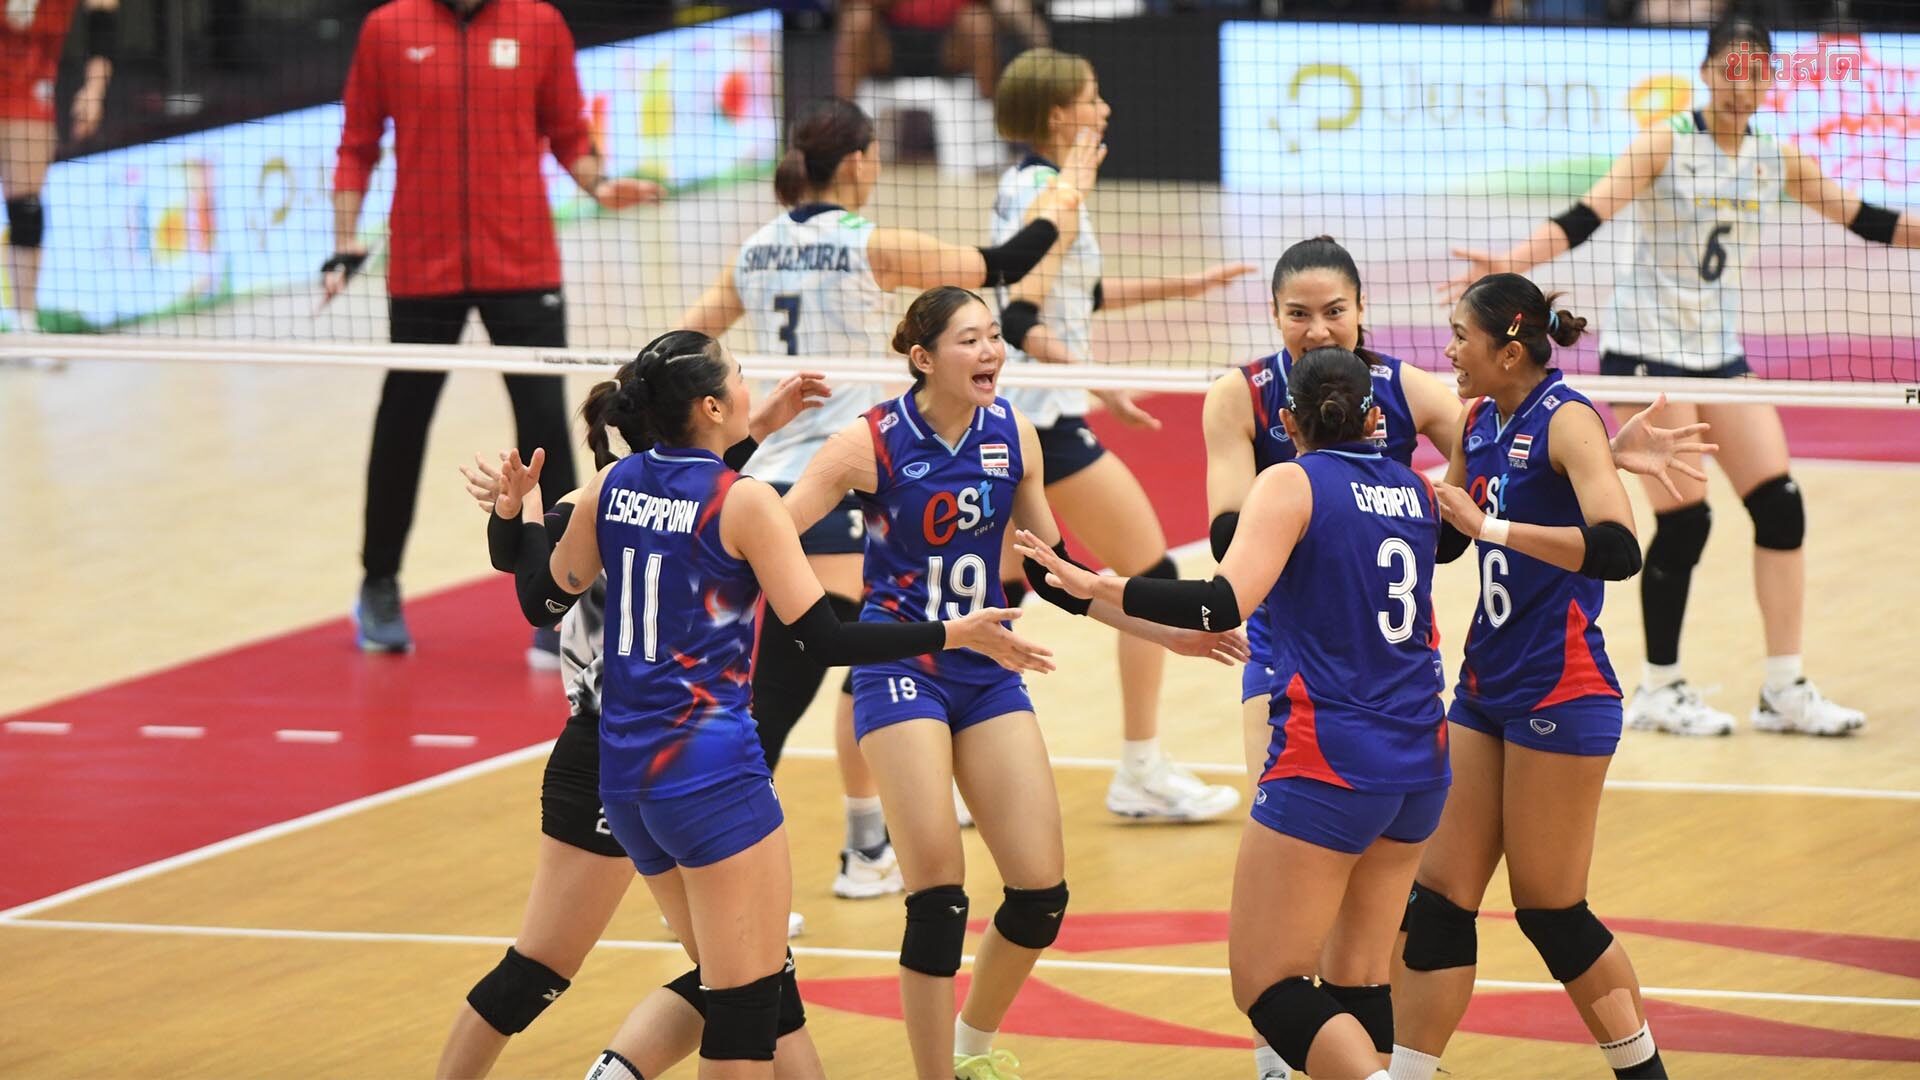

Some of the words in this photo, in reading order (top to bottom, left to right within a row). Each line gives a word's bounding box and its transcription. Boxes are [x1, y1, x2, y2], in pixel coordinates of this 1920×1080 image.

[743, 243, 851, 273] SHIMAMURA
[1701, 223, 1732, 282] 6
[848, 509, 864, 539] 3
[923, 480, 996, 546] est
[1468, 473, 1509, 519] est
[617, 546, 663, 662] 11
[925, 553, 987, 622] 19
[1376, 537, 1418, 644] 3
